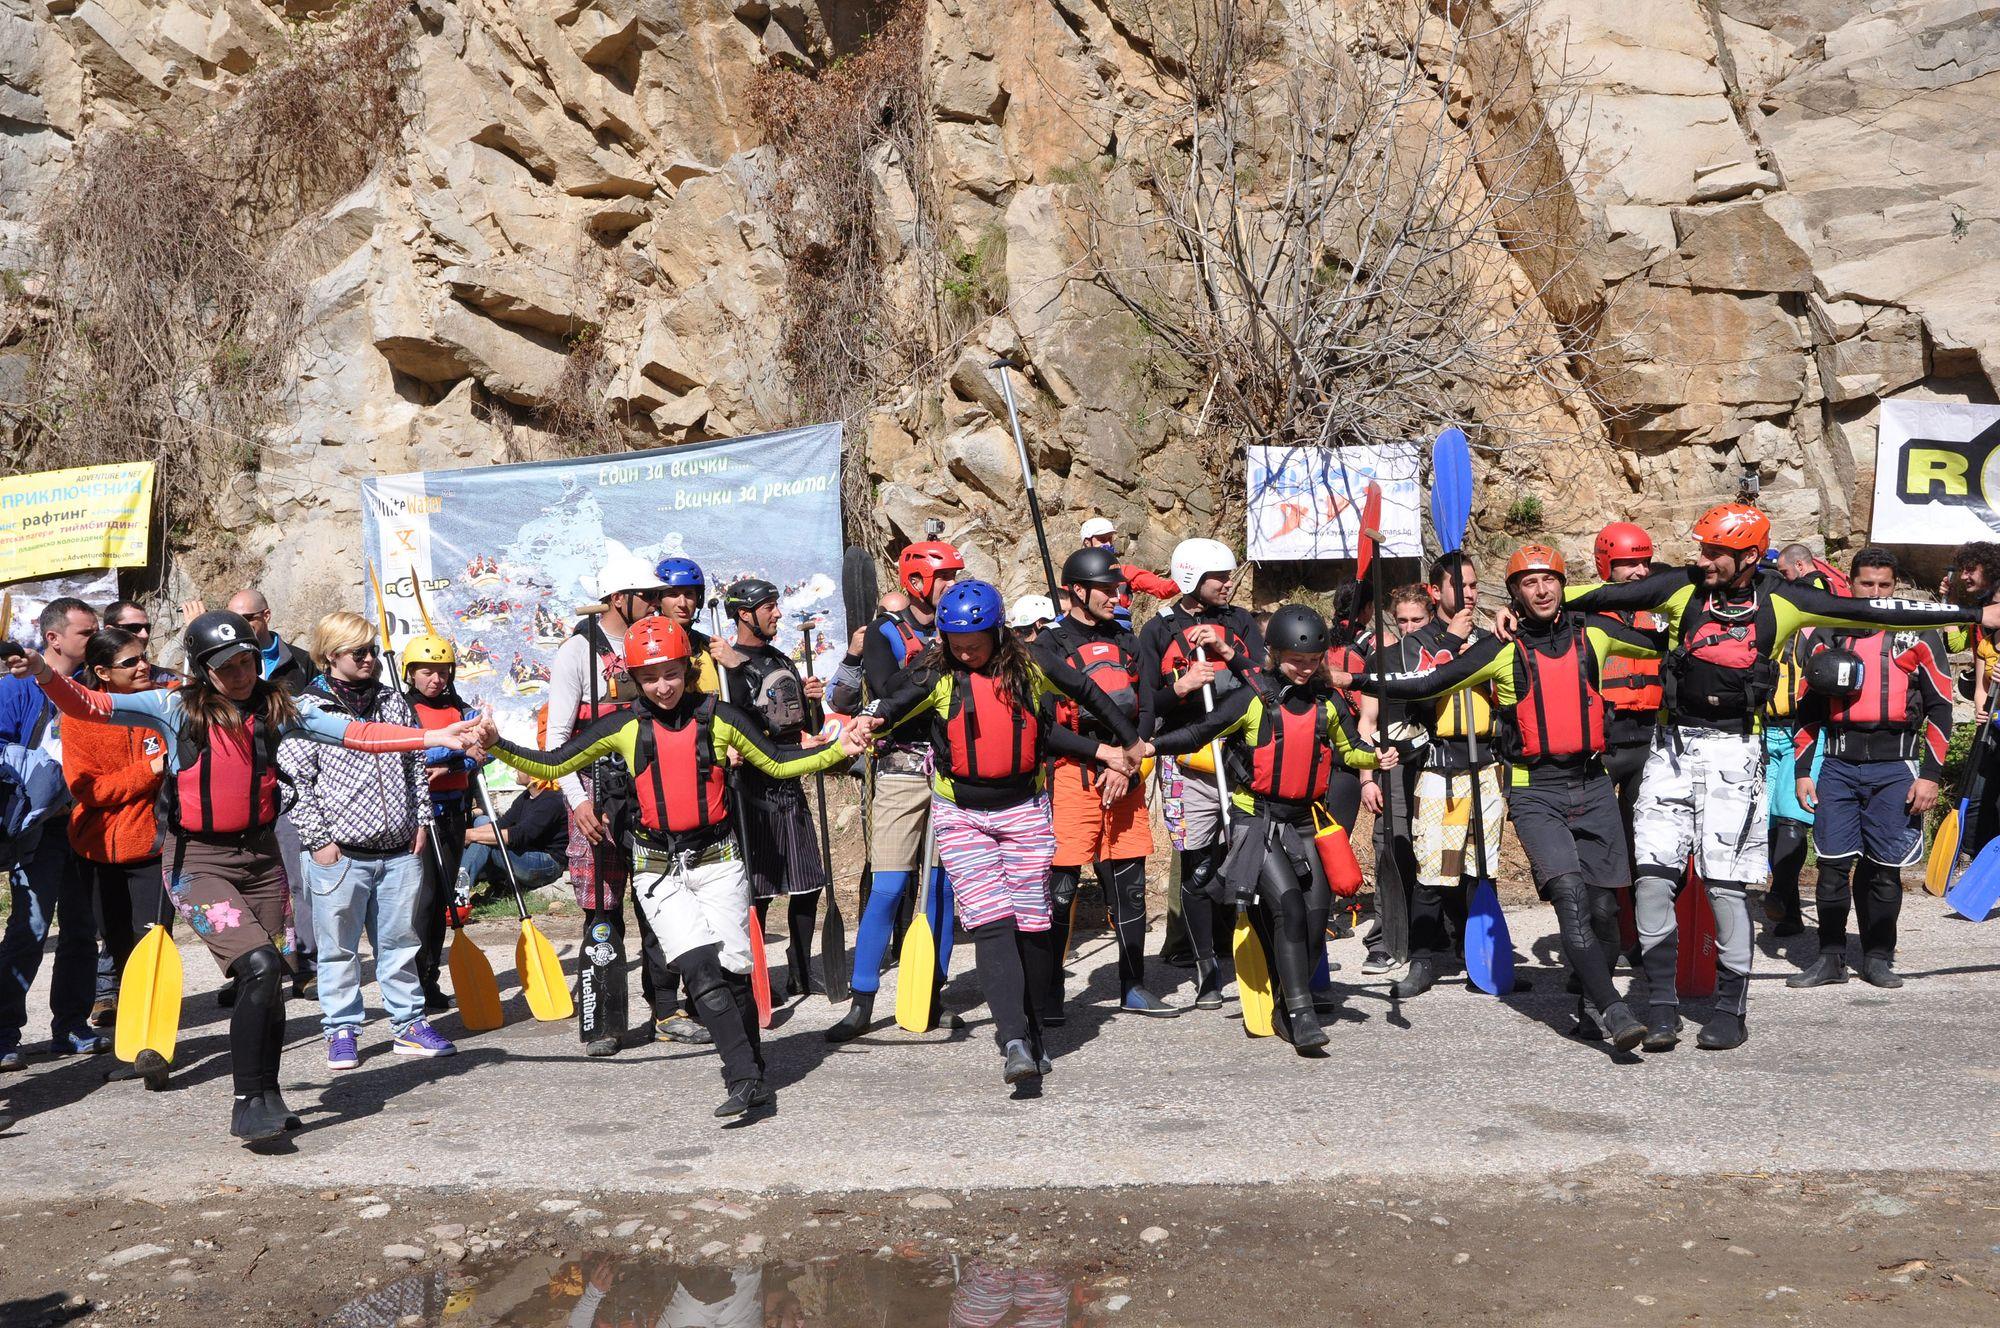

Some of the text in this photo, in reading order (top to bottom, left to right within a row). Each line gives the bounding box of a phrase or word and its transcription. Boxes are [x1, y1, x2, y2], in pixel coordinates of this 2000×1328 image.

[75, 470, 142, 483] ADVENTURE NET
[598, 464, 640, 486] Един
[645, 463, 664, 480] за
[738, 485, 758, 502] за
[22, 508, 88, 531] рафтинг
[582, 965, 597, 1032] TrueRiders
